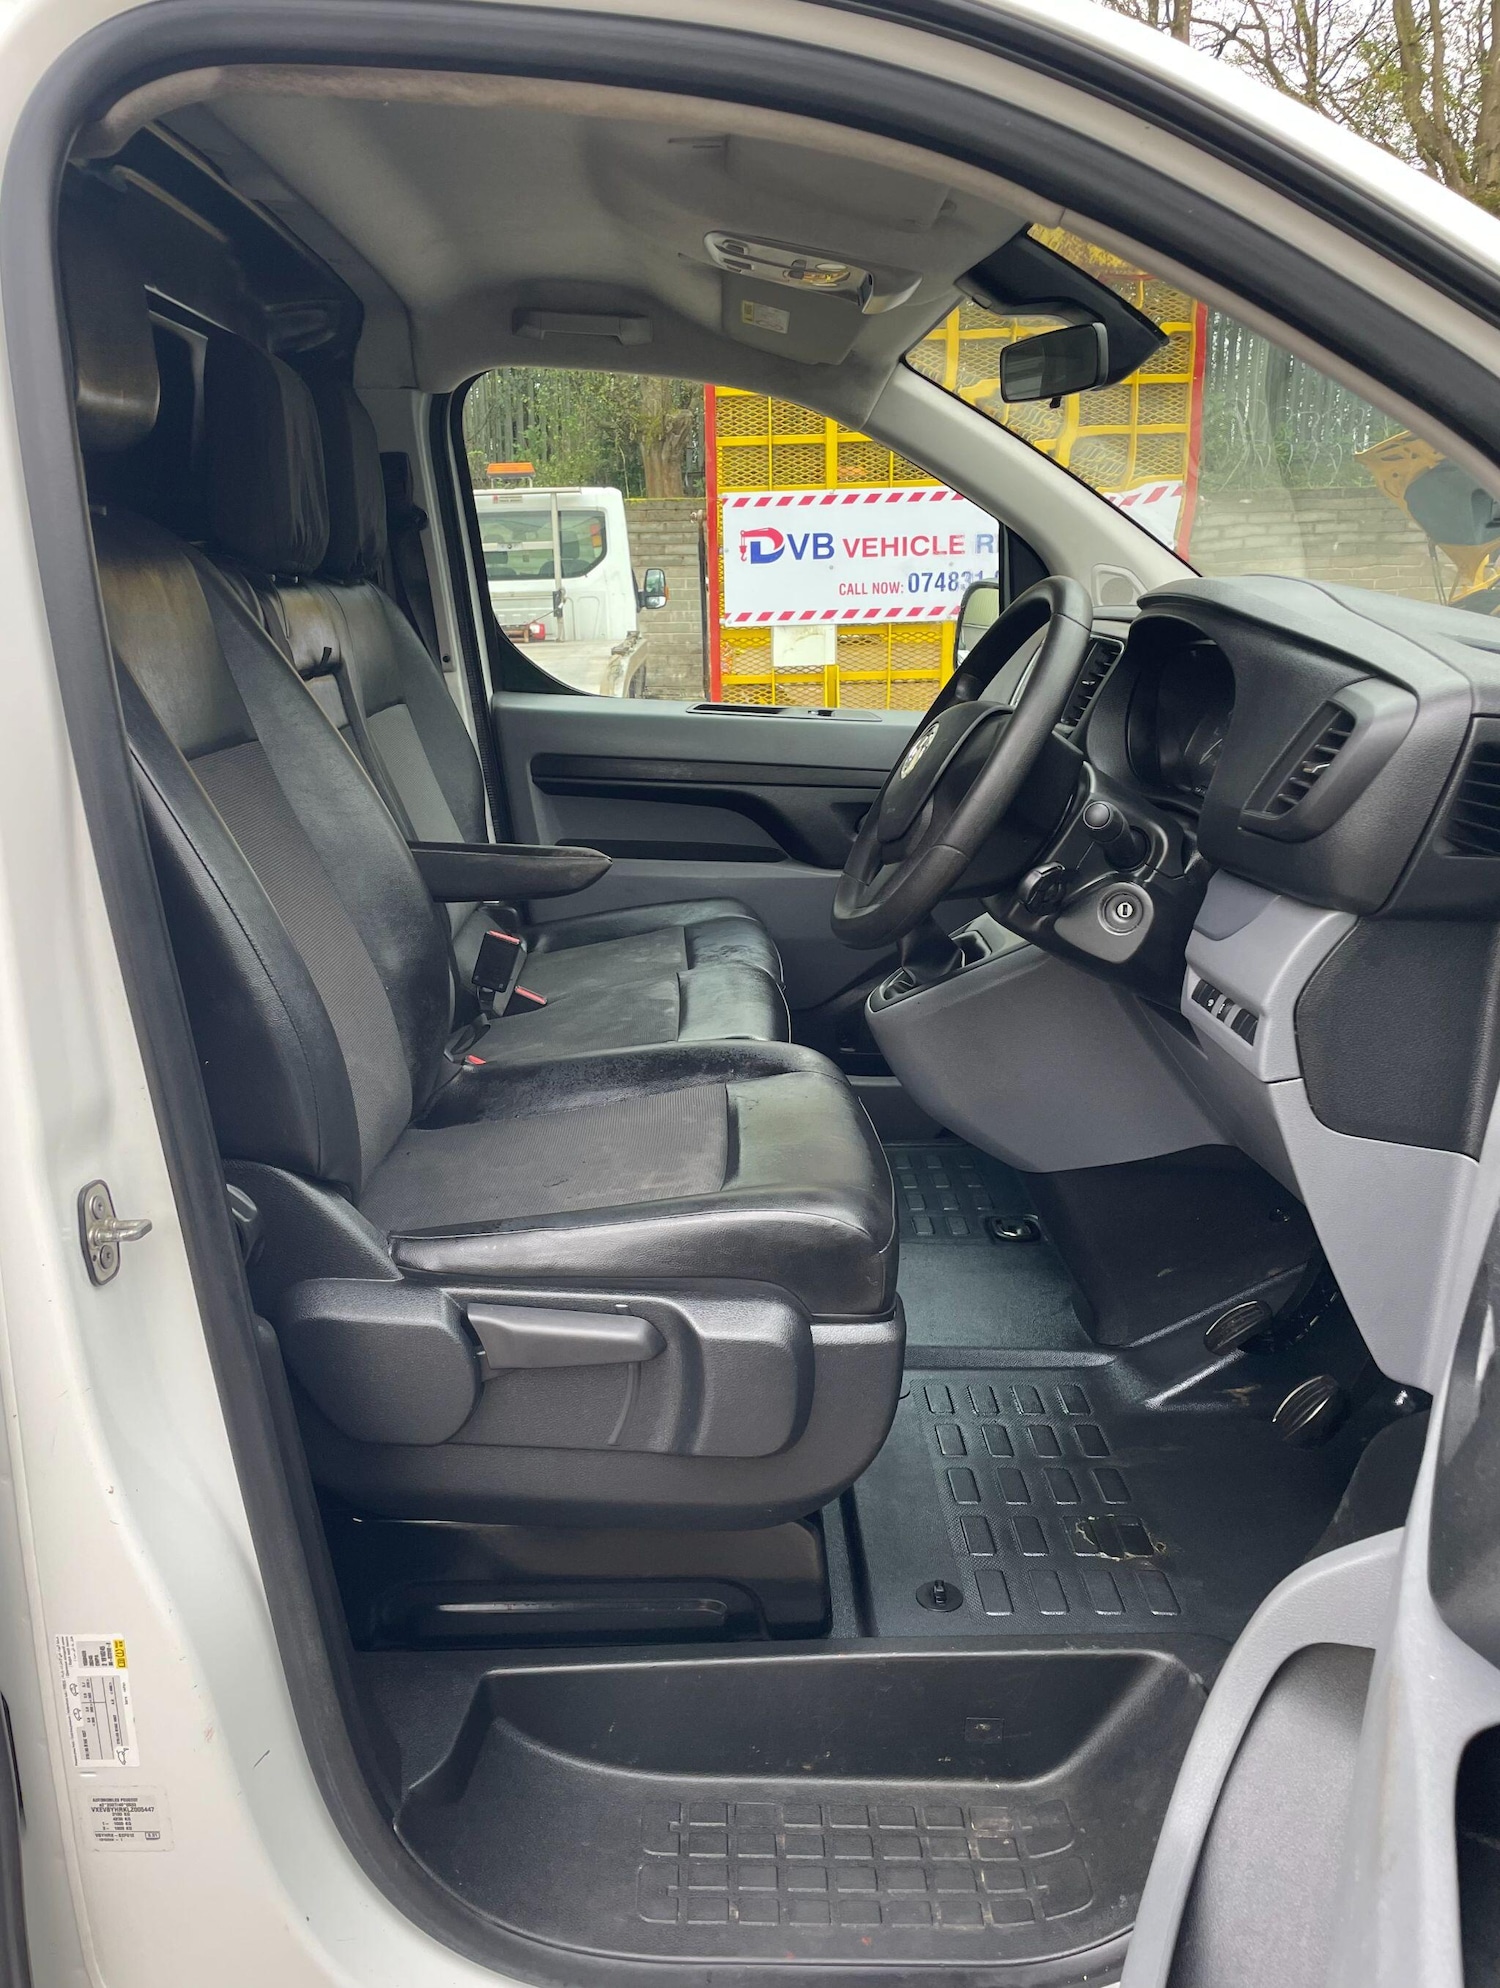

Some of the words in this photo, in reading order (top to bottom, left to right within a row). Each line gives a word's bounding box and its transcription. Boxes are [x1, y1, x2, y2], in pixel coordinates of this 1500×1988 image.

[740, 527, 835, 565] DVB
[842, 535, 966, 559] VEHICLE
[975, 533, 999, 555] R
[838, 582, 868, 596] CALL
[871, 581, 904, 595] NOW:
